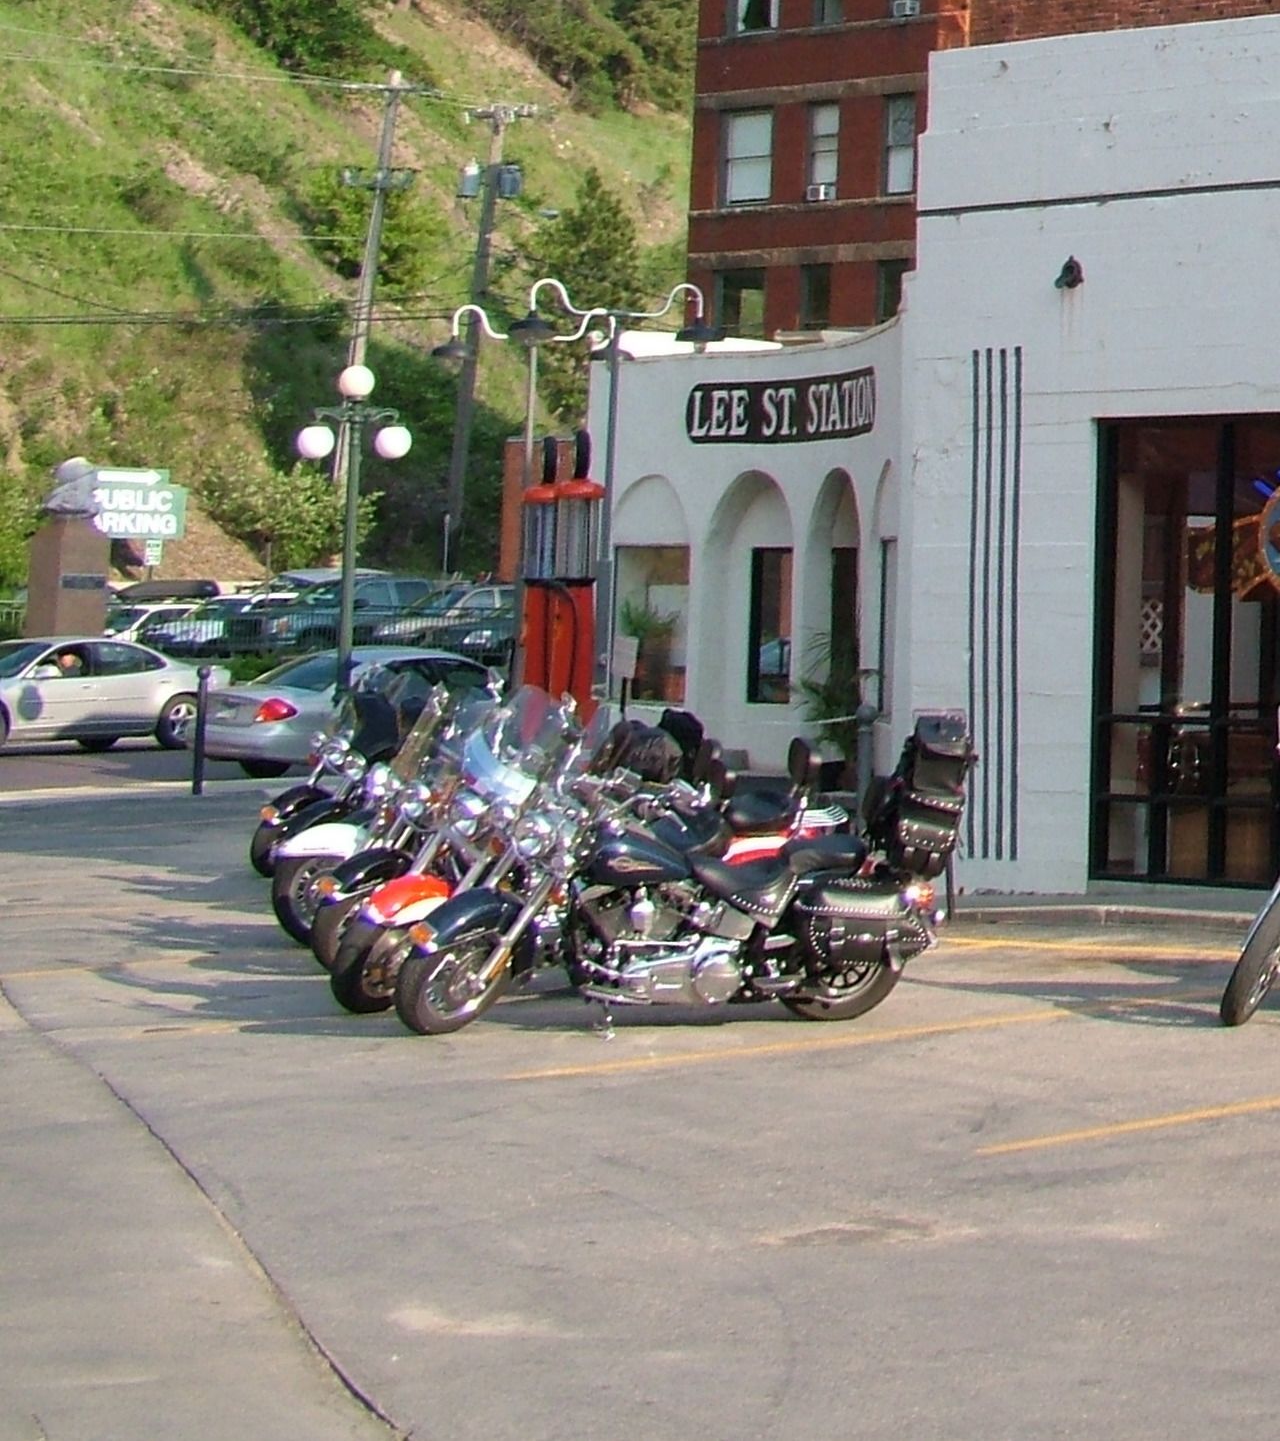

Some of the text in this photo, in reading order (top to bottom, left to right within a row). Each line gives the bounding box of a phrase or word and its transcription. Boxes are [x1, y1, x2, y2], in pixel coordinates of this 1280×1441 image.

[690, 375, 875, 438] LEE ST. STATION
[93, 512, 178, 535] RKING
